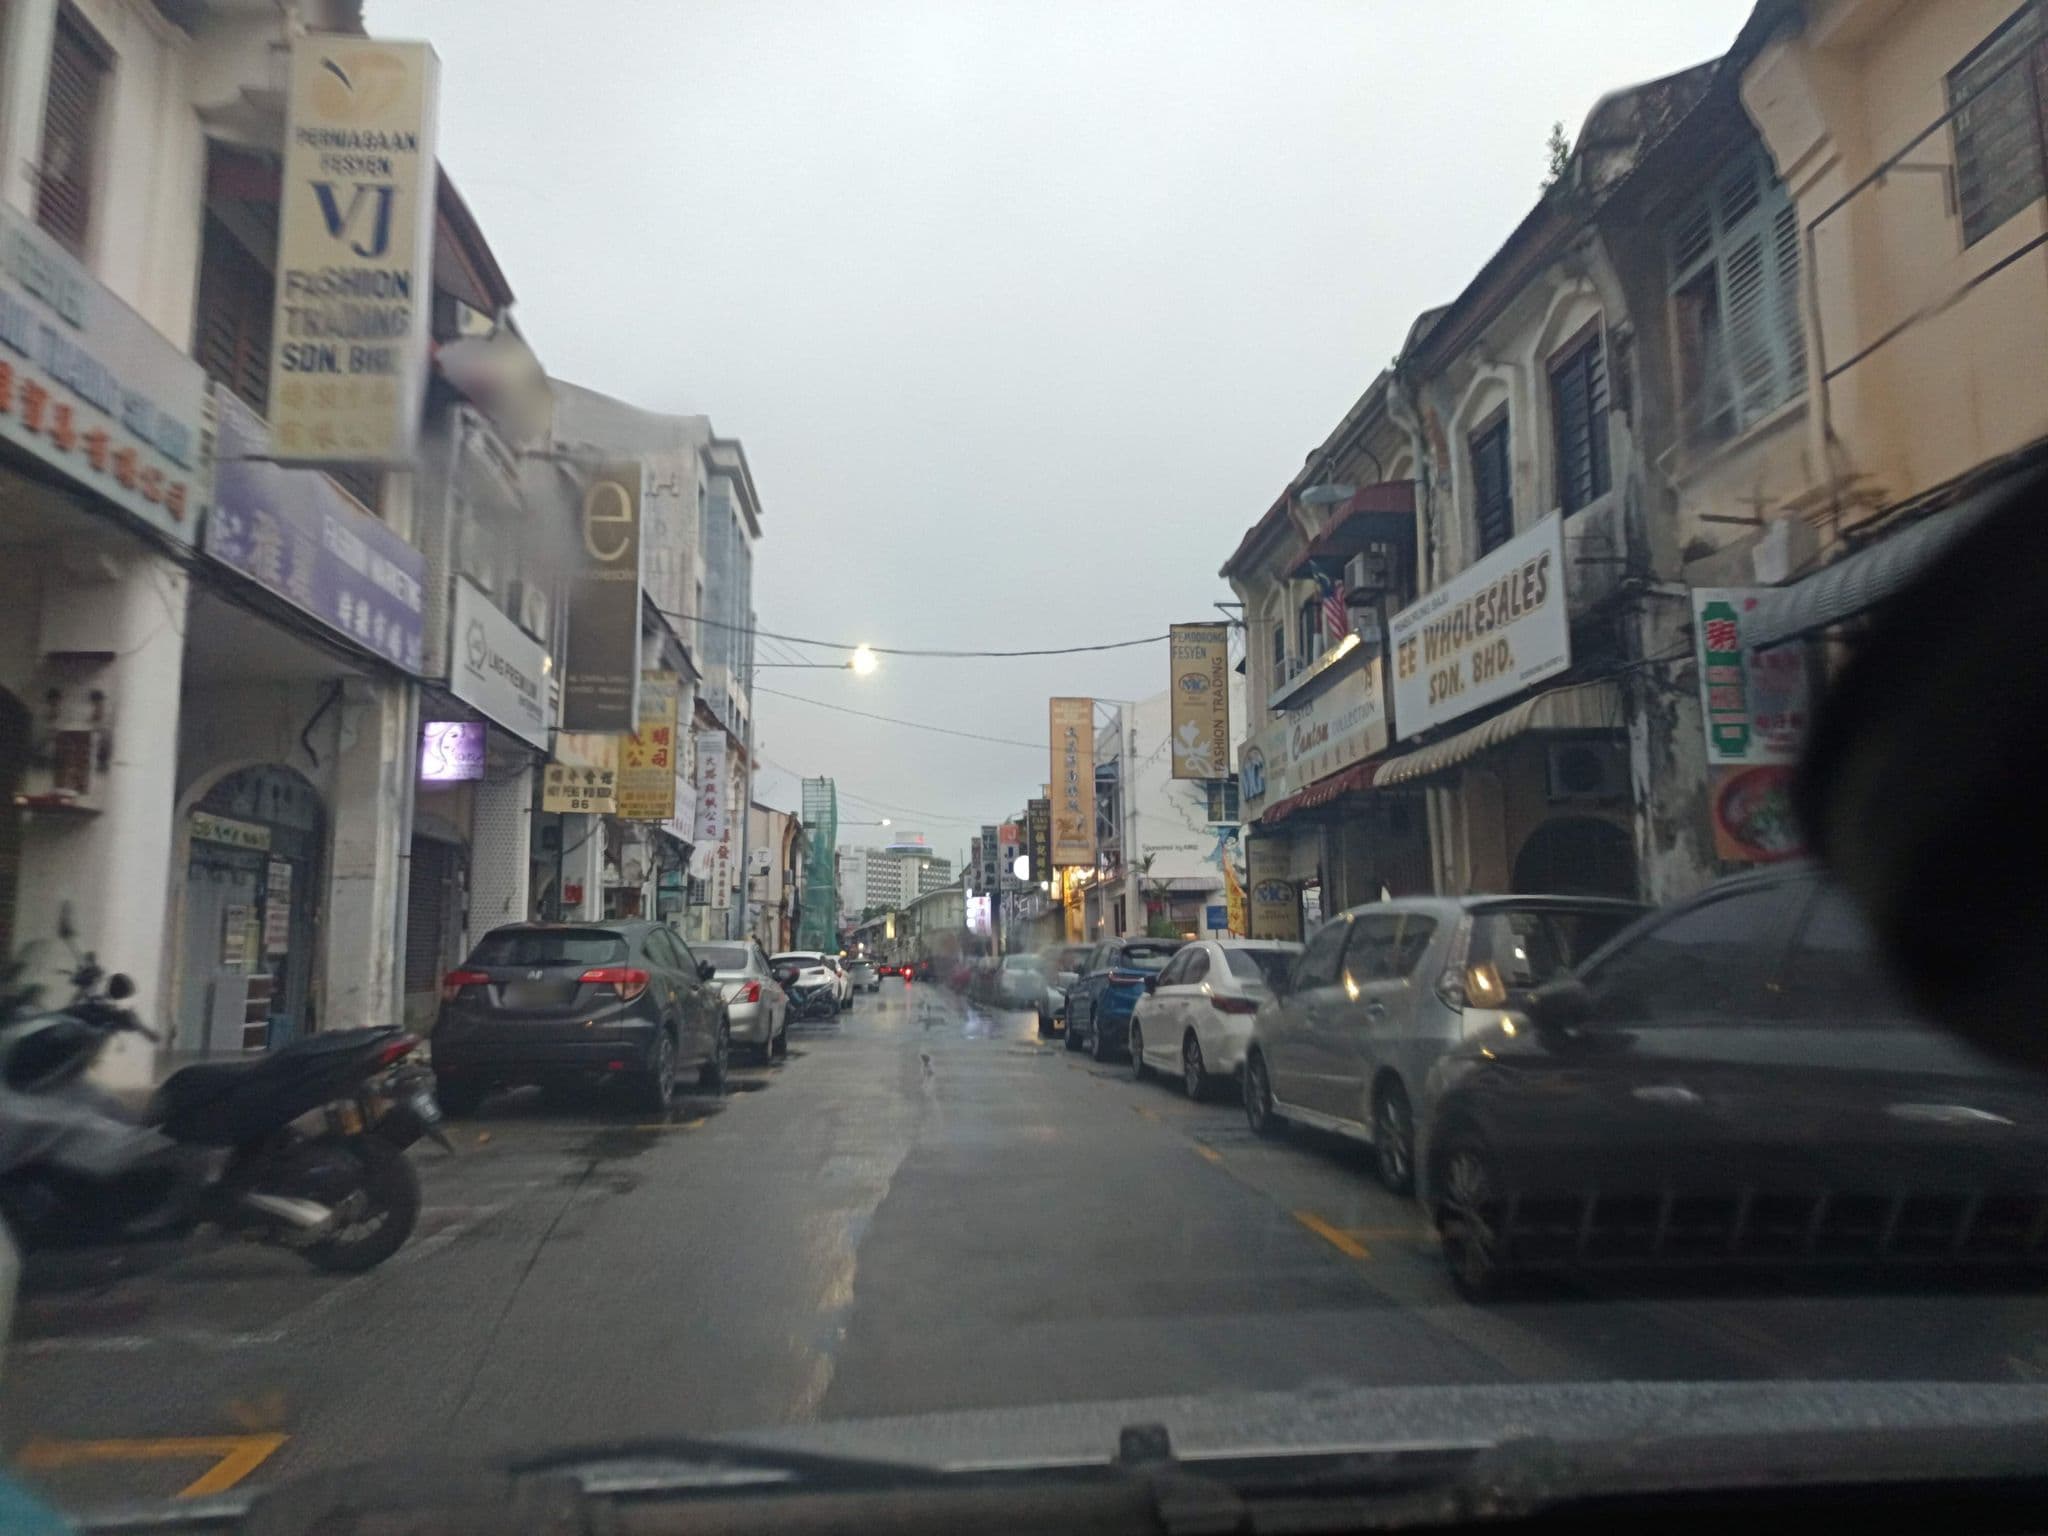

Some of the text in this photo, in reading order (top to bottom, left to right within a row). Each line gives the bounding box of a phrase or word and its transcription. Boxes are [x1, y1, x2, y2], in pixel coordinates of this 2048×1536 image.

[307, 180, 400, 258] VJ
[285, 269, 411, 299] FASHION
[583, 480, 632, 561] e
[1423, 554, 1550, 665] WHOLESALES
[1172, 646, 1207, 660] FESYEN
[1429, 664, 1465, 706] SDN.
[1472, 638, 1515, 684] BHD.
[1211, 656, 1225, 772] FASHION TRADING
